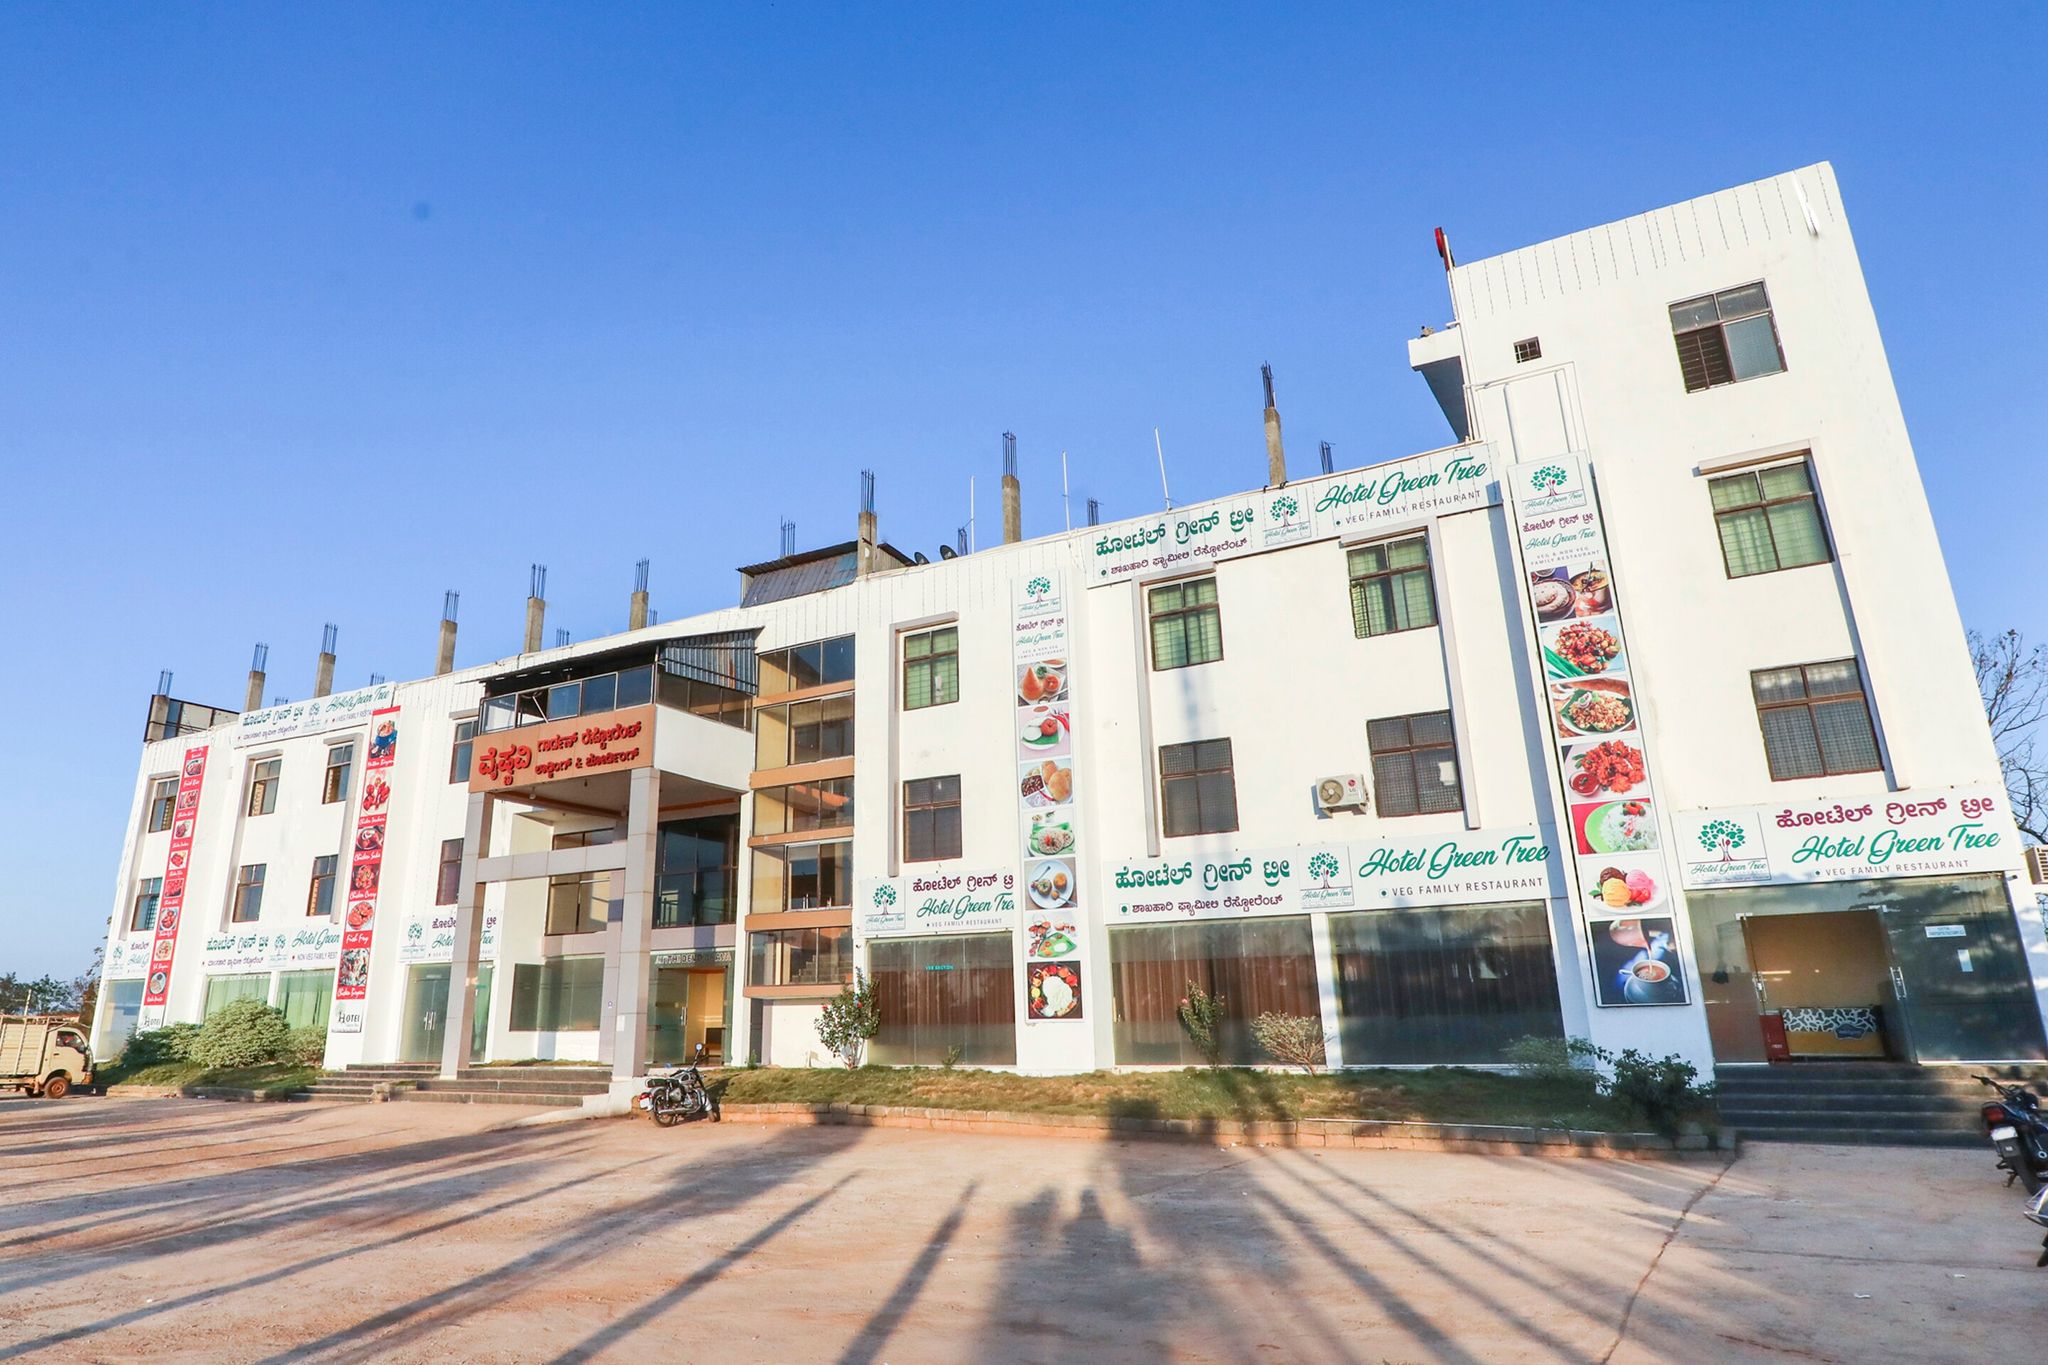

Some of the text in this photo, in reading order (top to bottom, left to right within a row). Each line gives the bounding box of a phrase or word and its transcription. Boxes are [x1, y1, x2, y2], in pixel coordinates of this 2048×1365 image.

[1316, 456, 1487, 512] Hotel Green Tree
[1346, 490, 1481, 524] VEG FAMILY RESTAURANT
[1096, 507, 1254, 556] ಹೋಟೆಲ್ ಗ್ರೀನ್ ಟ್ರೀ
[1525, 528, 1596, 550] Hotel Green Tree
[1558, 550, 1600, 561] RESTAURANT
[1775, 797, 1995, 828] ಹೋಟೆಲ್ ಗ್ರೀನ್ ಟ್ರೀ
[1791, 823, 2000, 865] Hotel Green Tree
[1359, 835, 1550, 880] Hotel Green Tree
[1691, 860, 1767, 874] Hotel Green Tree
[1825, 859, 1969, 877] VEG FAMILY RESTAURANT
[913, 876, 961, 892] ಹೋಟೆಲ್
[967, 873, 998, 892] ಗ್ರೀನ್
[1115, 857, 1290, 891] ಹೋಟೆಲ್ ಗ್ರೀನ್ ಟ್ರೀ
[1302, 889, 1320, 900] Hotel
[1320, 888, 1338, 900] Green
[1392, 877, 1544, 897] VEG FAMILY RESTAURANT
[916, 897, 953, 917] Hotel
[954, 895, 992, 920] Green
[966, 918, 1002, 926] RESTAURANT
